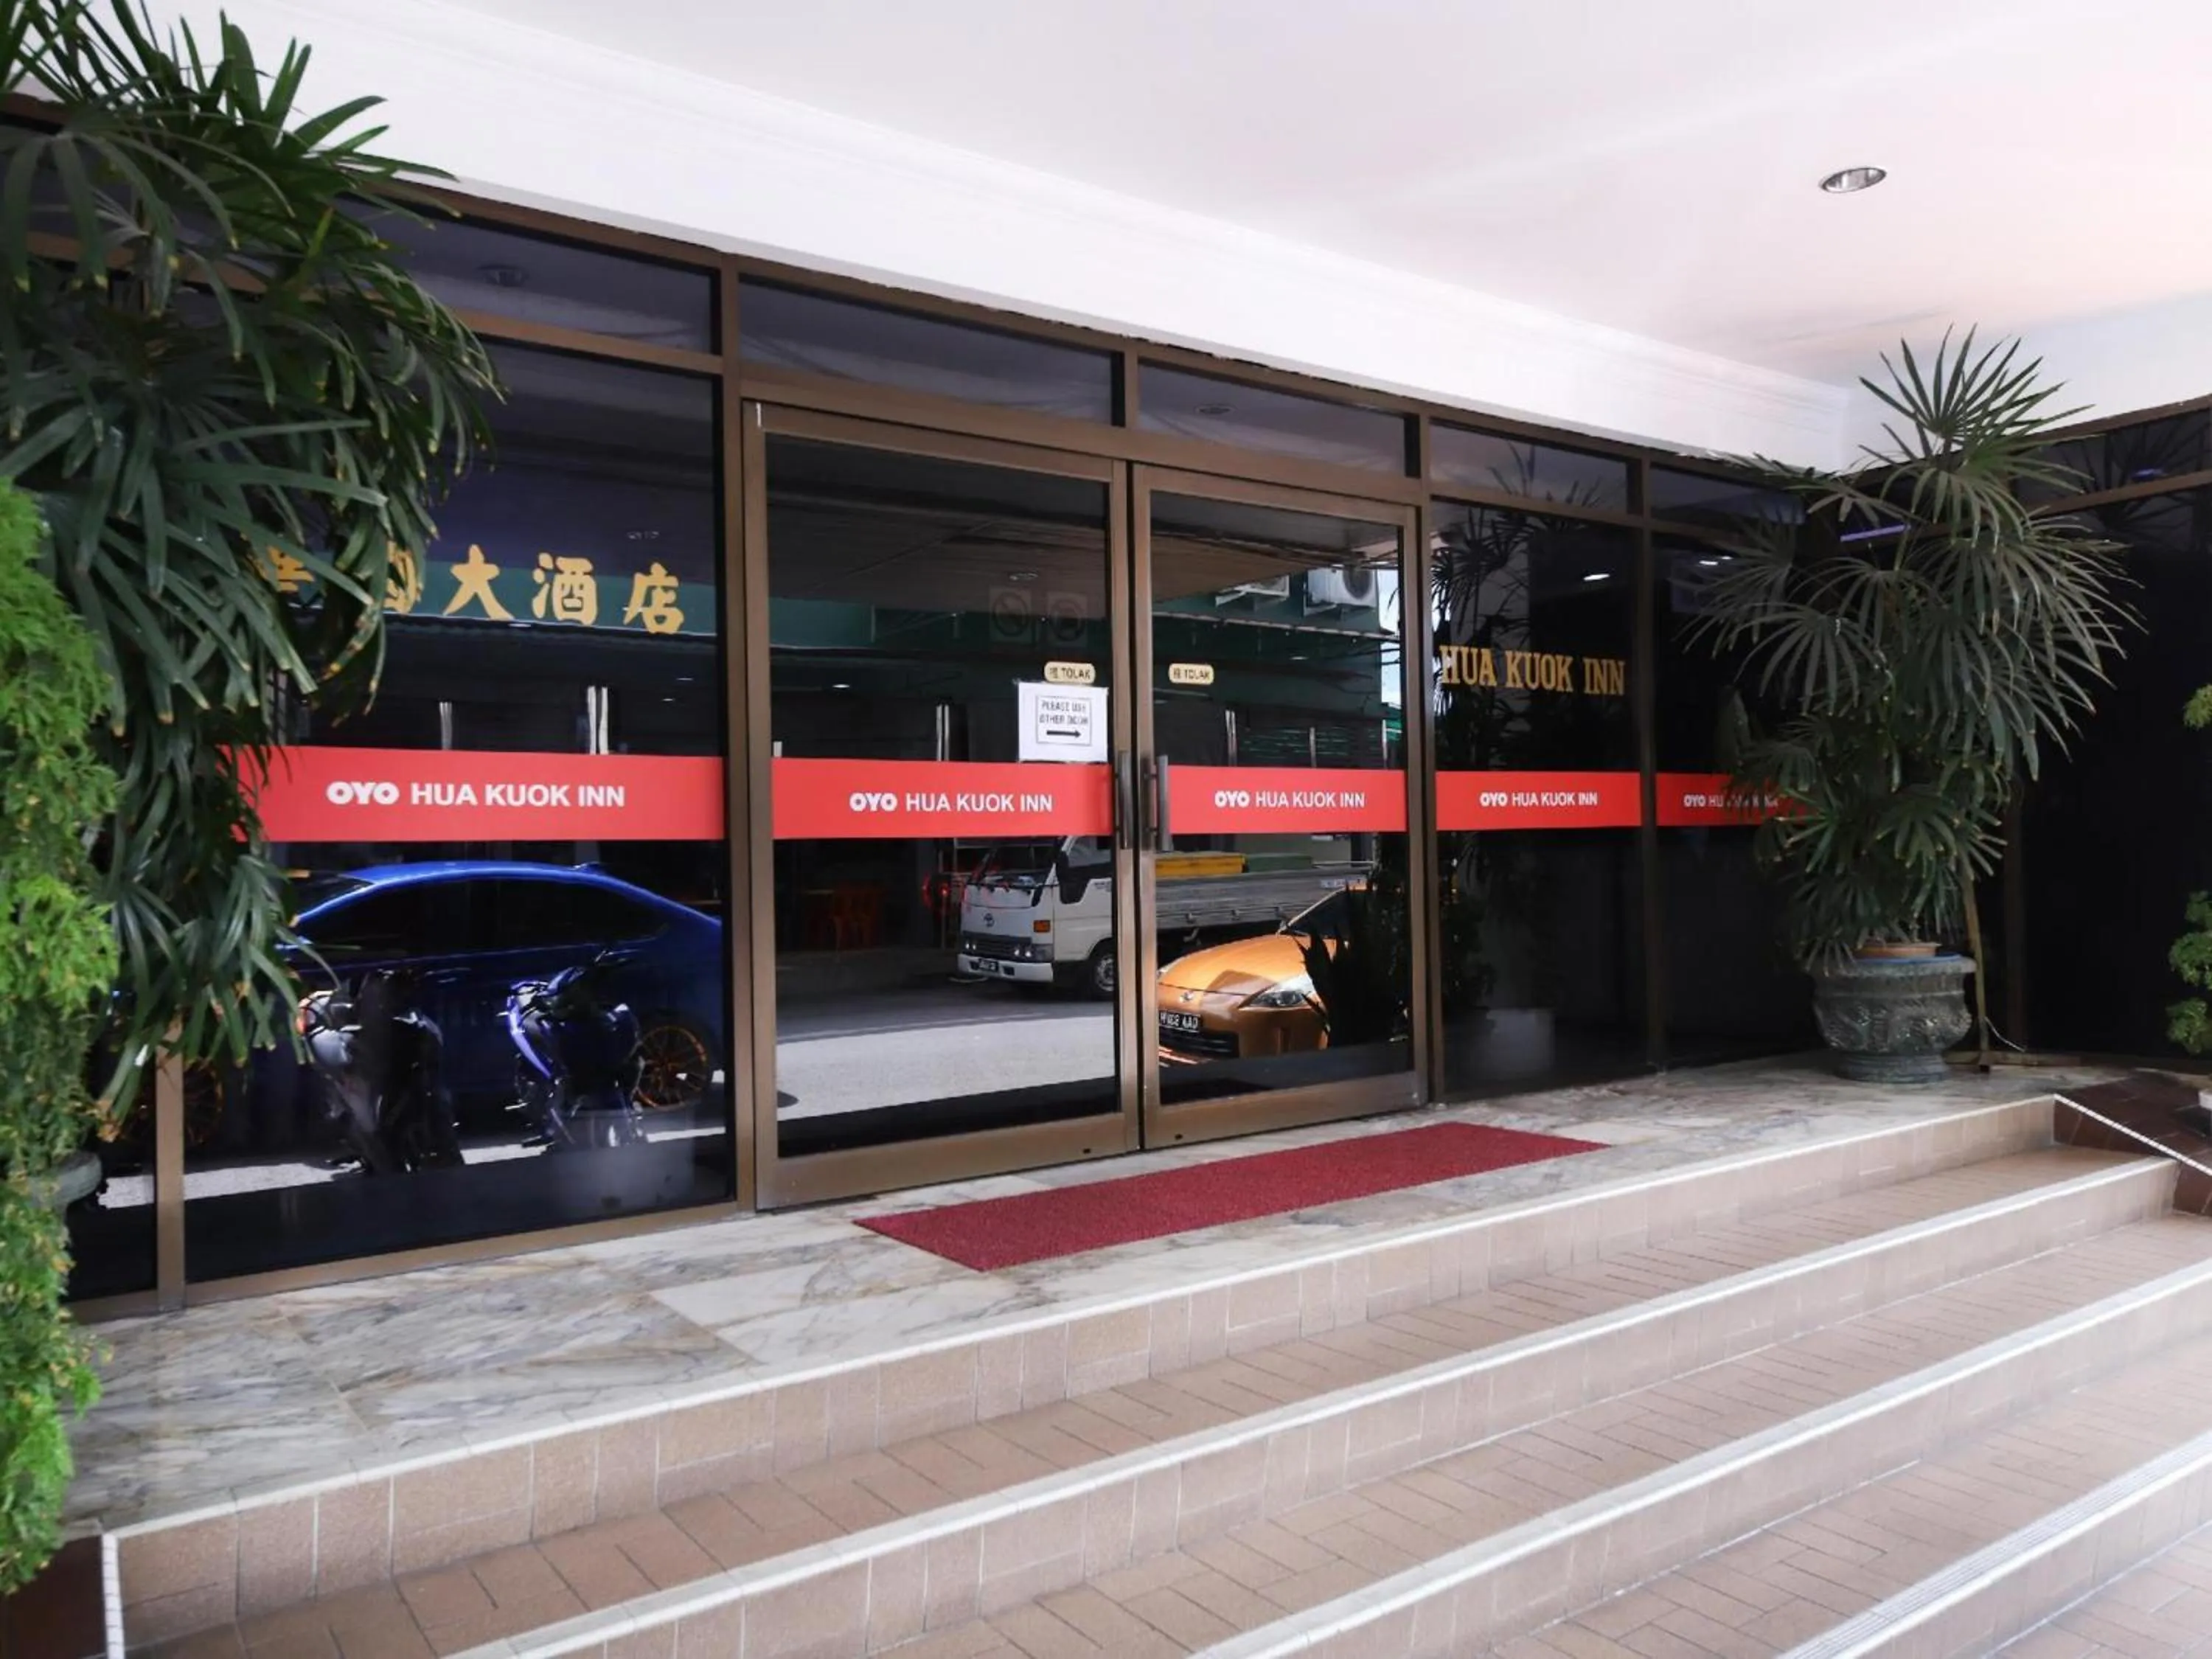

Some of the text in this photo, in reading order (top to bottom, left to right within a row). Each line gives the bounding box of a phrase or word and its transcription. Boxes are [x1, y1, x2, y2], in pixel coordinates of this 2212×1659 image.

[1061, 667, 1091, 679] TOLAK
[1439, 645, 1626, 695] HUA KUOK INN
[326, 781, 625, 807] OYO HUA KUOK INN
[849, 793, 1052, 813] OYO HUA KUOK INN
[1214, 790, 1365, 808] OYO HUA KUOK INN
[1479, 792, 1598, 807] OYO HUA KUOK INN
[1683, 794, 1707, 807] OYO
